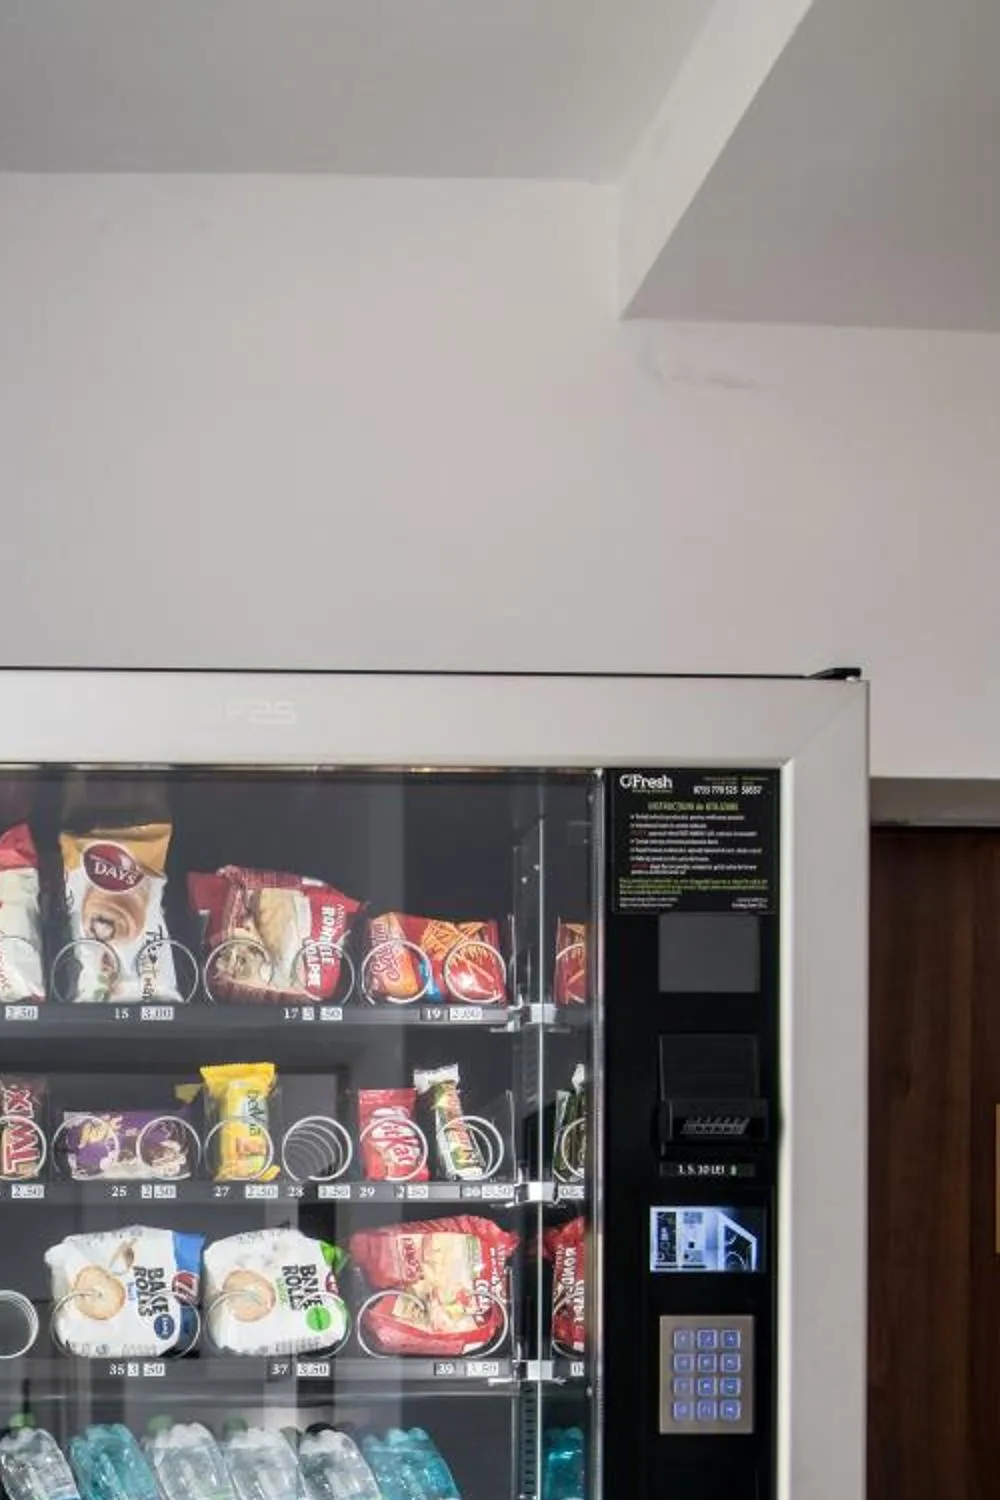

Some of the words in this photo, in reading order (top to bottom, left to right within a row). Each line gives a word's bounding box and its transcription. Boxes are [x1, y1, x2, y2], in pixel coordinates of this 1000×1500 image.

[93, 861, 140, 885] DAYS
[133, 1265, 153, 1317] ROLLS
[148, 1266, 170, 1316] BAKE
